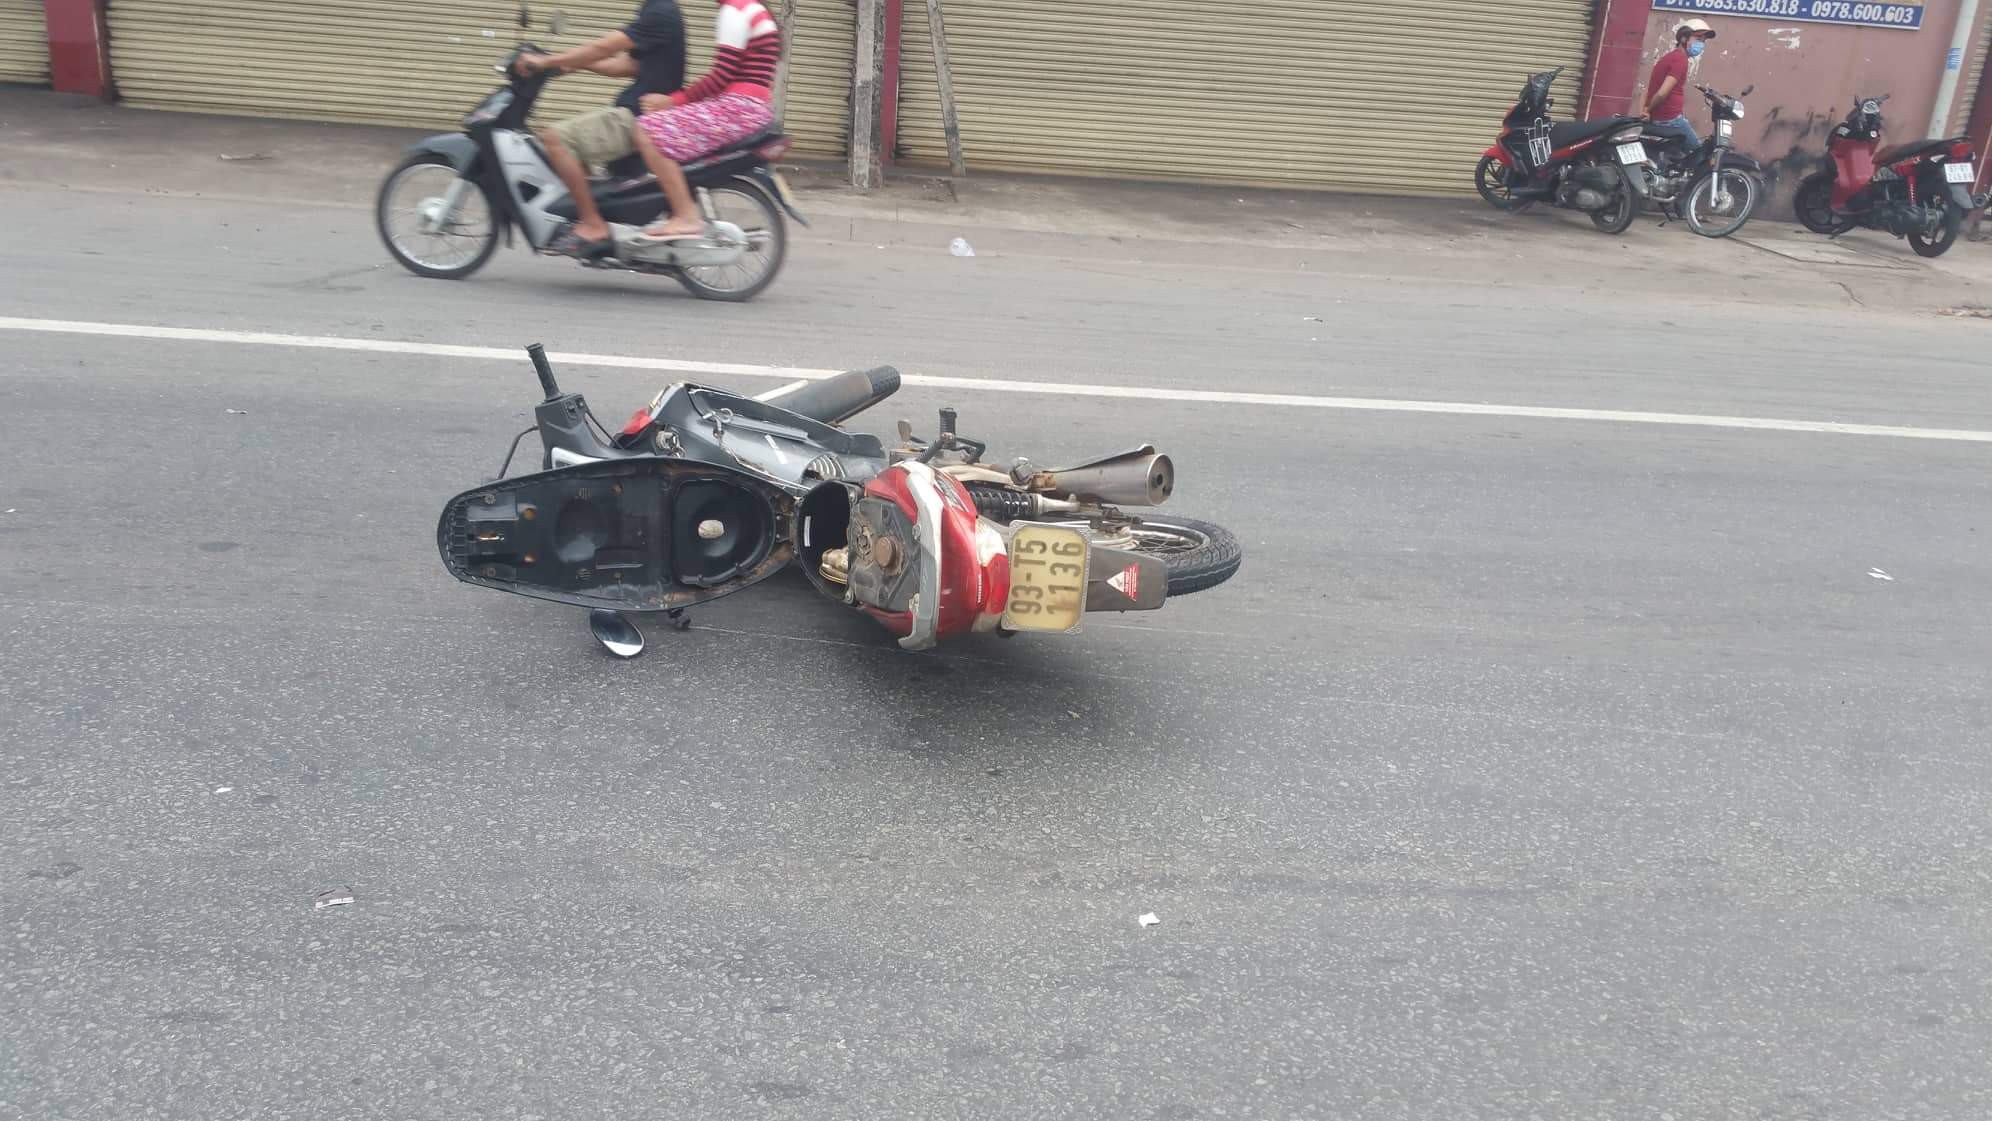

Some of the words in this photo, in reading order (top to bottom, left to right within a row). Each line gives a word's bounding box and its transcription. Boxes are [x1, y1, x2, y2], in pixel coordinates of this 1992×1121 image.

[1811, 0, 1914, 23] 0978.600.603
[1010, 539, 1047, 614] 93-T5
[1047, 541, 1081, 614] 1136
